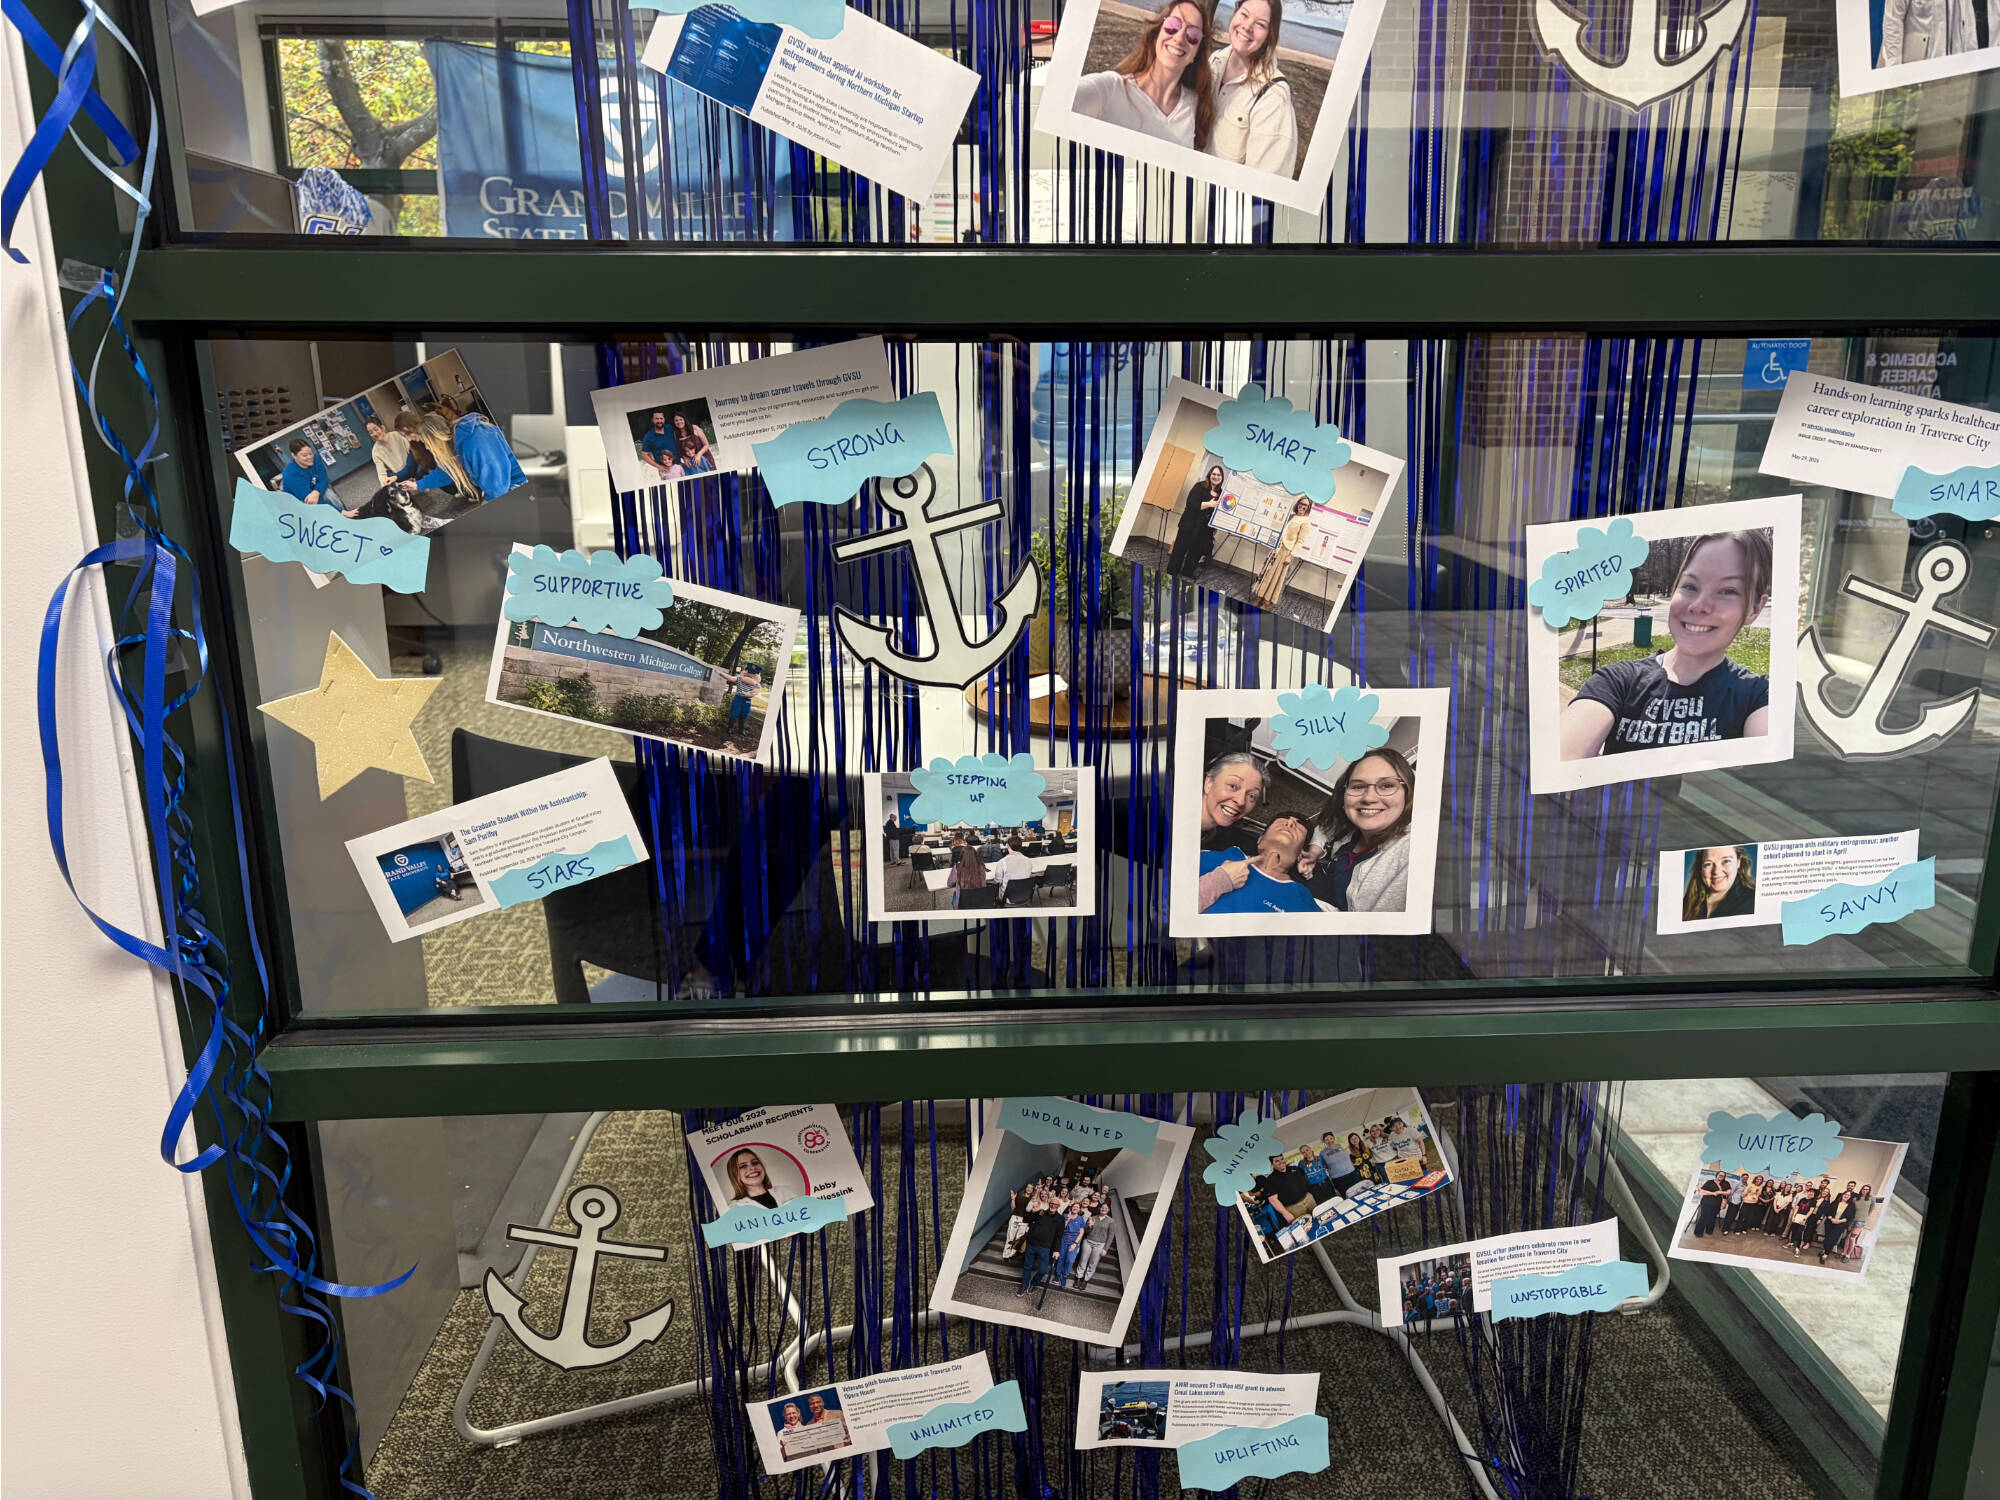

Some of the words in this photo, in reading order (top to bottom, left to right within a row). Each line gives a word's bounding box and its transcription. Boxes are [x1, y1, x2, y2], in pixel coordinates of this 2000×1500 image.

[778, 56, 797, 72] Week
[786, 35, 806, 50] GVSU
[805, 44, 818, 57] will
[817, 51, 832, 64] host
[831, 58, 855, 77] applied
[854, 70, 863, 80] AI
[862, 74, 892, 96] workshop
[891, 88, 902, 100] for
[781, 47, 826, 75] entrepreneurs
[825, 69, 846, 86] during
[845, 79, 873, 99] Northern
[872, 92, 901, 113] Michigan
[900, 106, 925, 126] Startup
[796, 83, 812, 95] Grand
[811, 90, 826, 102] Valley
[836, 104, 859, 119] University
[714, 395, 739, 408] Journey
[740, 394, 747, 402] to
[748, 389, 768, 400] dream
[770, 385, 790, 396] career
[792, 379, 815, 392] travels
[815, 374, 841, 388] through
[841, 370, 861, 382] GVSU
[1812, 381, 1867, 404] Hands-on
[1867, 393, 1914, 416] learning
[1913, 403, 1950, 424] sparks
[1950, 409, 1999, 432] healthcar
[1806, 401, 1840, 419] career
[1839, 406, 1904, 436] exploration
[1904, 422, 1917, 433] in
[1917, 422, 1965, 444] Traverse
[1964, 432, 1991, 453] City
[807, 422, 905, 470] STRONG
[1246, 423, 1316, 466] SMART
[1930, 480, 2000, 502] SMAR
[278, 513, 373, 562] SWEET
[533, 574, 644, 600] SUPPORTIVE
[1555, 554, 1622, 596] SPIRITED
[542, 629, 636, 663] Northwestern
[639, 653, 678, 671] Michigan
[679, 663, 703, 678] College
[1645, 696, 1704, 720] GVSU
[1295, 711, 1346, 736] SILLY
[1616, 717, 1722, 744] FOOTBALL
[946, 774, 1007, 789] STEPPING
[970, 793, 985, 803] UP
[459, 827, 471, 835] The
[470, 818, 497, 832] Graduate
[496, 811, 519, 824] Student
[518, 805, 538, 817] Within
[538, 802, 549, 811] the
[463, 835, 477, 845] Sam
[1763, 843, 1779, 851] GVSU
[1780, 842, 1803, 850] program
[1817, 839, 1838, 848] military
[1781, 850, 1803, 859] planned
[1812, 848, 1825, 856] start
[1833, 847, 1846, 855] April
[527, 857, 596, 889] STARS
[1820, 881, 1898, 922] SAVVY
[702, 1122, 724, 1135] MEET
[726, 1116, 744, 1127] OUR
[745, 1109, 767, 1121] 2026
[705, 1121, 763, 1145] SCHOLARSHIP
[765, 1105, 814, 1126] RECIPIENTS
[1021, 1107, 1123, 1141] UNDAUNTED
[1224, 1132, 1261, 1176] UNITED
[1738, 1133, 1814, 1153] UNITED
[813, 1181, 837, 1193] Abby
[734, 1207, 811, 1232] UNIQUE
[1476, 1256, 1497, 1265] location
[1506, 1252, 1525, 1260] classes
[1533, 1247, 1555, 1257] Traverse
[1556, 1246, 1567, 1255] City
[1507, 1243, 1530, 1252] partners
[1531, 1239, 1556, 1250] celebrate
[1510, 1284, 1608, 1304] UNSTOPPABLE
[841, 1383, 864, 1392] Veterans
[864, 1379, 877, 1388] pitch
[877, 1375, 900, 1384] business
[900, 1371, 923, 1381] solutions
[929, 1366, 951, 1375] Traverse
[951, 1363, 962, 1371] City
[843, 1391, 859, 1399] Opera
[859, 1387, 875, 1396] House
[910, 1409, 994, 1442] UNLIMITED
[1214, 1434, 1300, 1464] UPLIFTING
